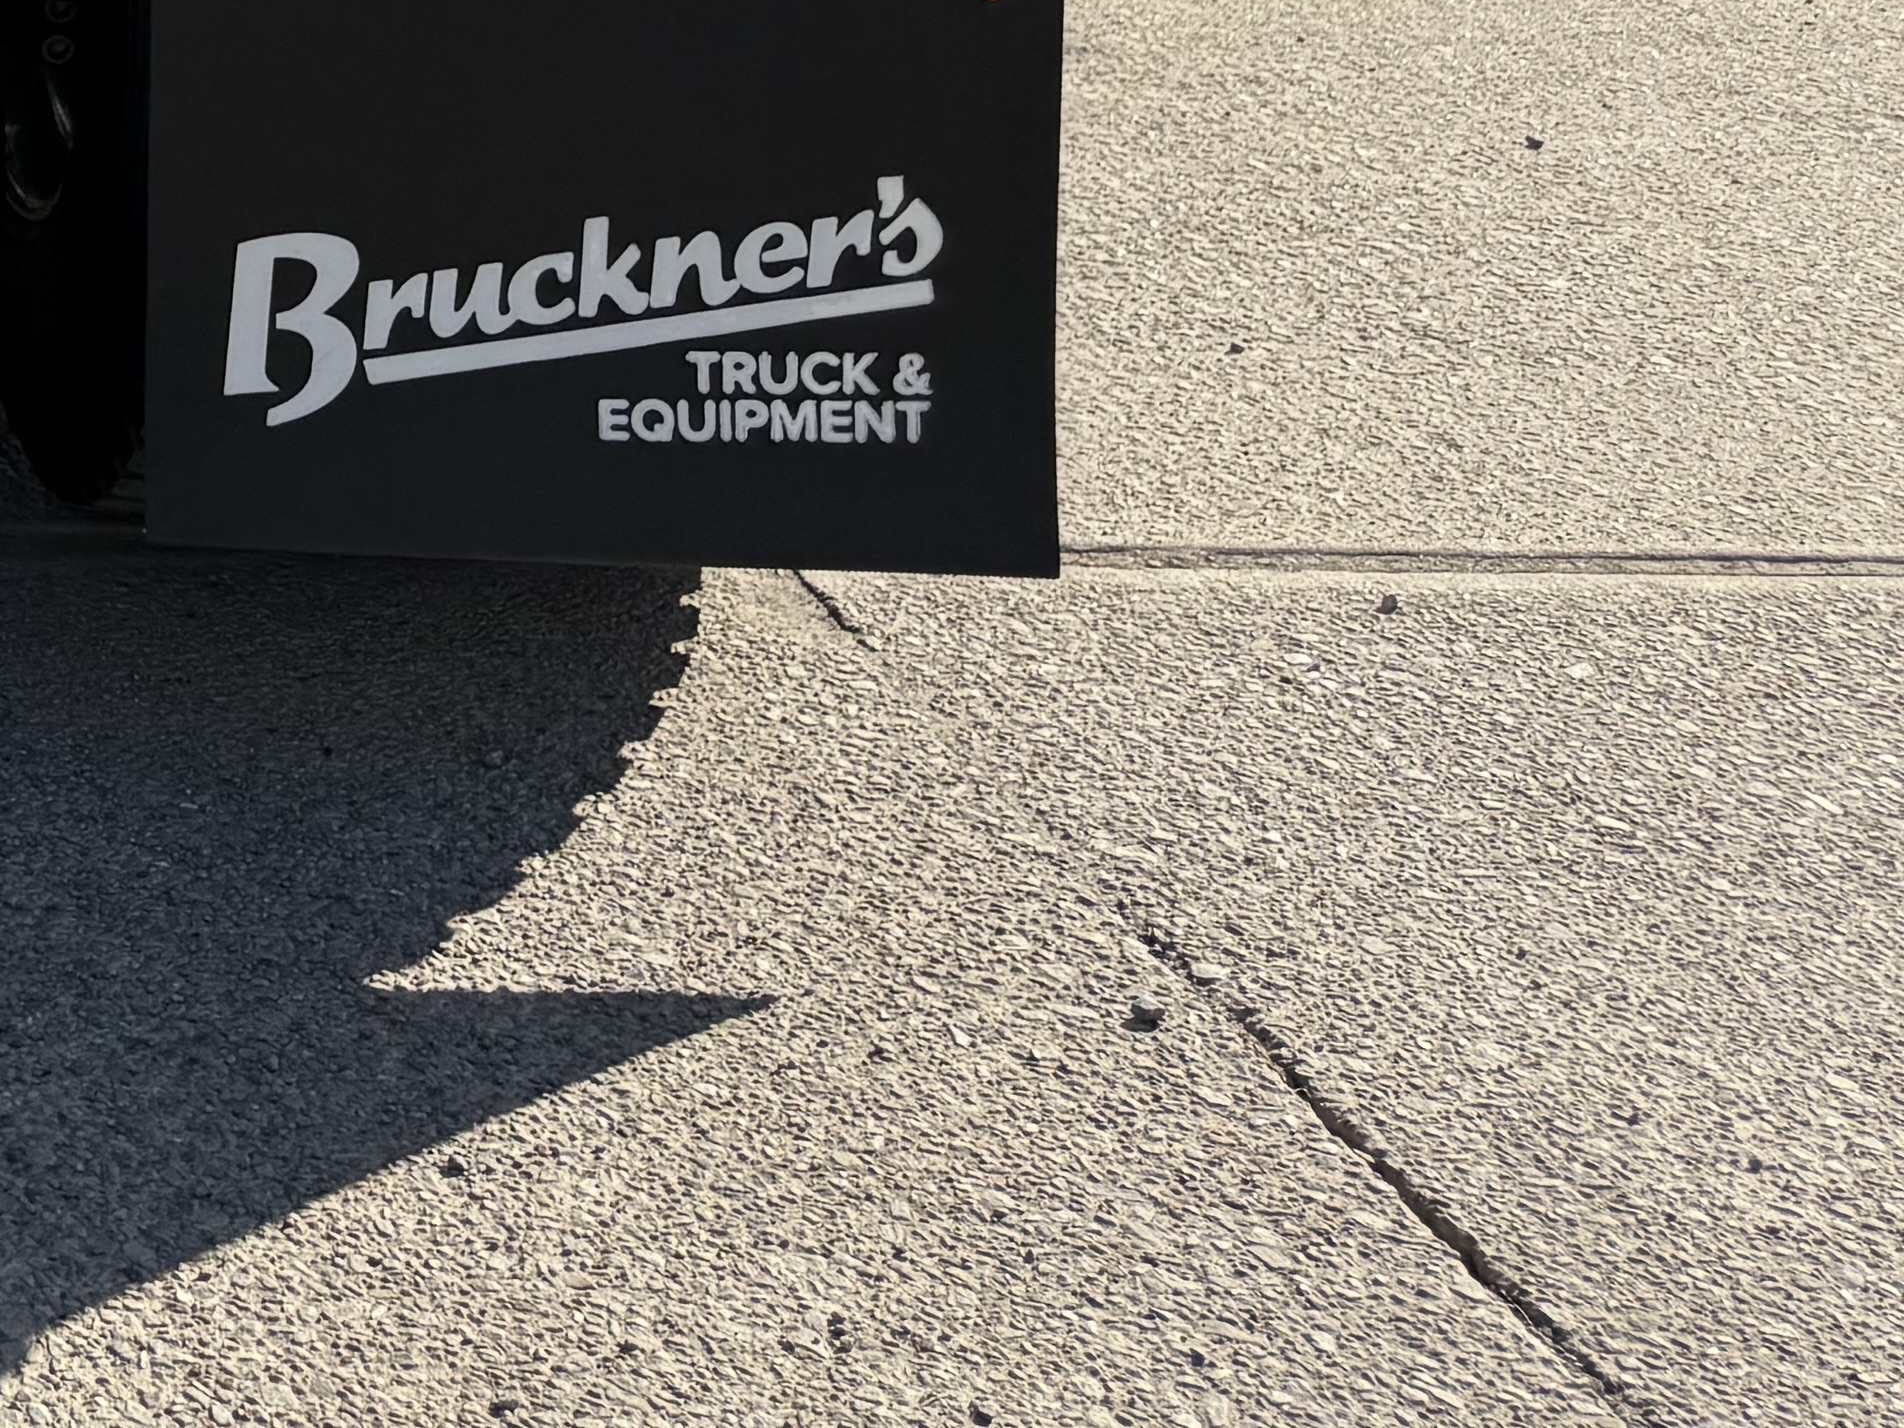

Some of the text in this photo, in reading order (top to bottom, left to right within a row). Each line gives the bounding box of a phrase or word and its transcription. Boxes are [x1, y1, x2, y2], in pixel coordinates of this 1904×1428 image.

[224, 176, 943, 426] Bruckner's
[686, 351, 933, 395] TRUCK &
[598, 399, 932, 443] EQUIPMENT
